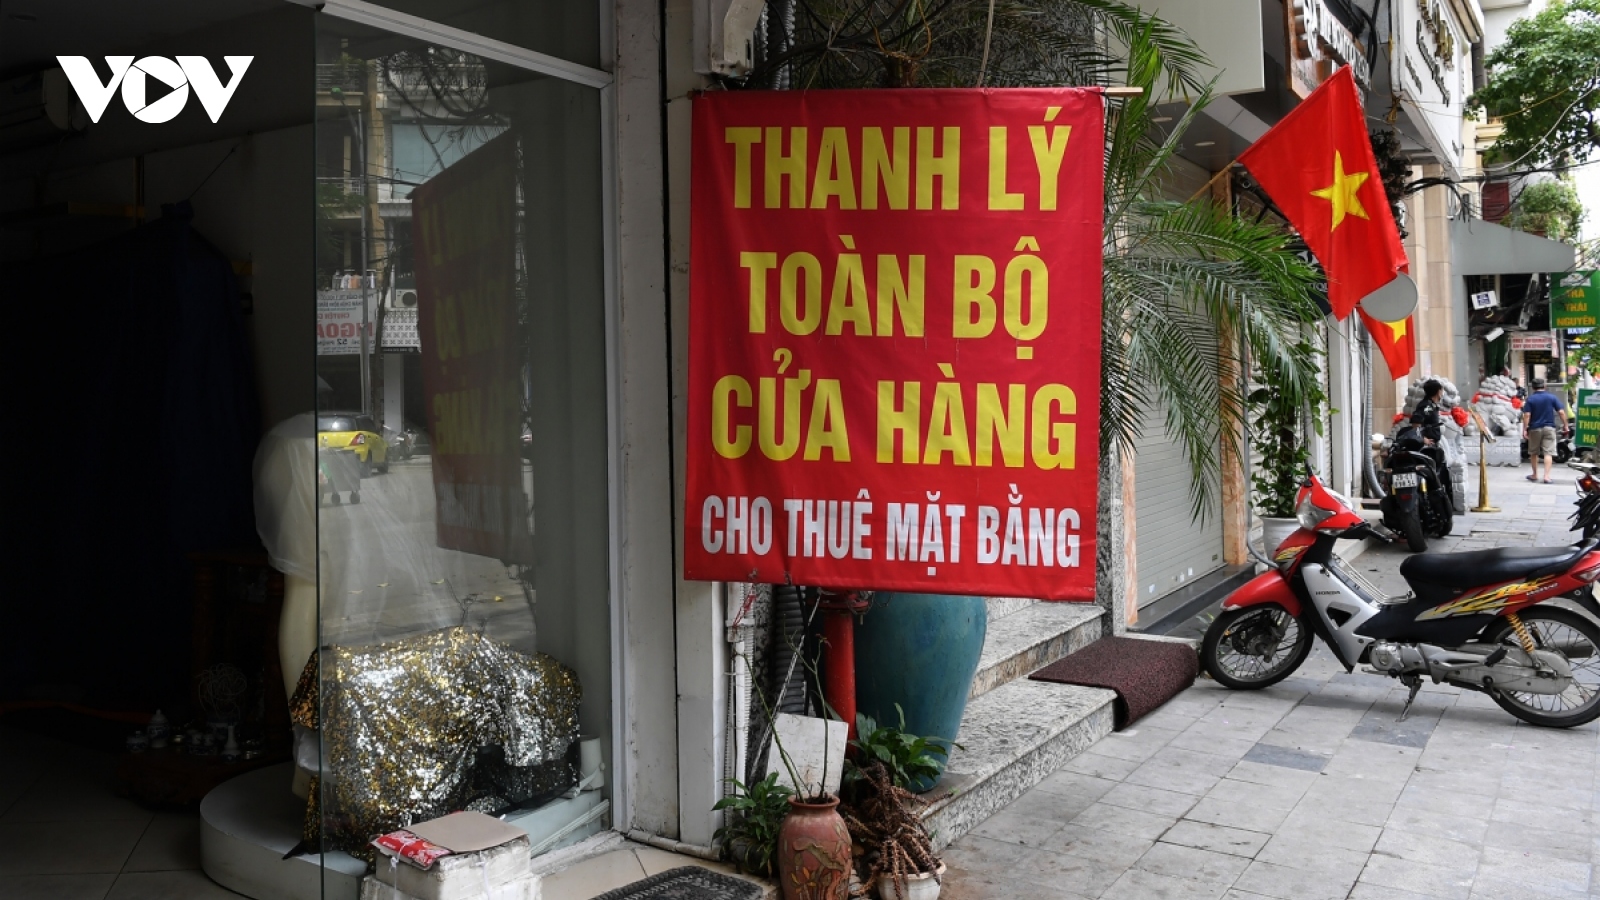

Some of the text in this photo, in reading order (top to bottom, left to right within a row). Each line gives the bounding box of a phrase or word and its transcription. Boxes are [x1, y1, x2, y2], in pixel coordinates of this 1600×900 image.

[724, 106, 1072, 211] THANH LÝ
[740, 234, 1049, 359] TOÀN BỘ
[1556, 315, 1596, 326] NGUYÊN
[1564, 301, 1588, 312] THÁI
[711, 348, 1076, 470] CỬA HÀNG
[701, 482, 1082, 577] CHO THUÊ MẶT BẰNG
